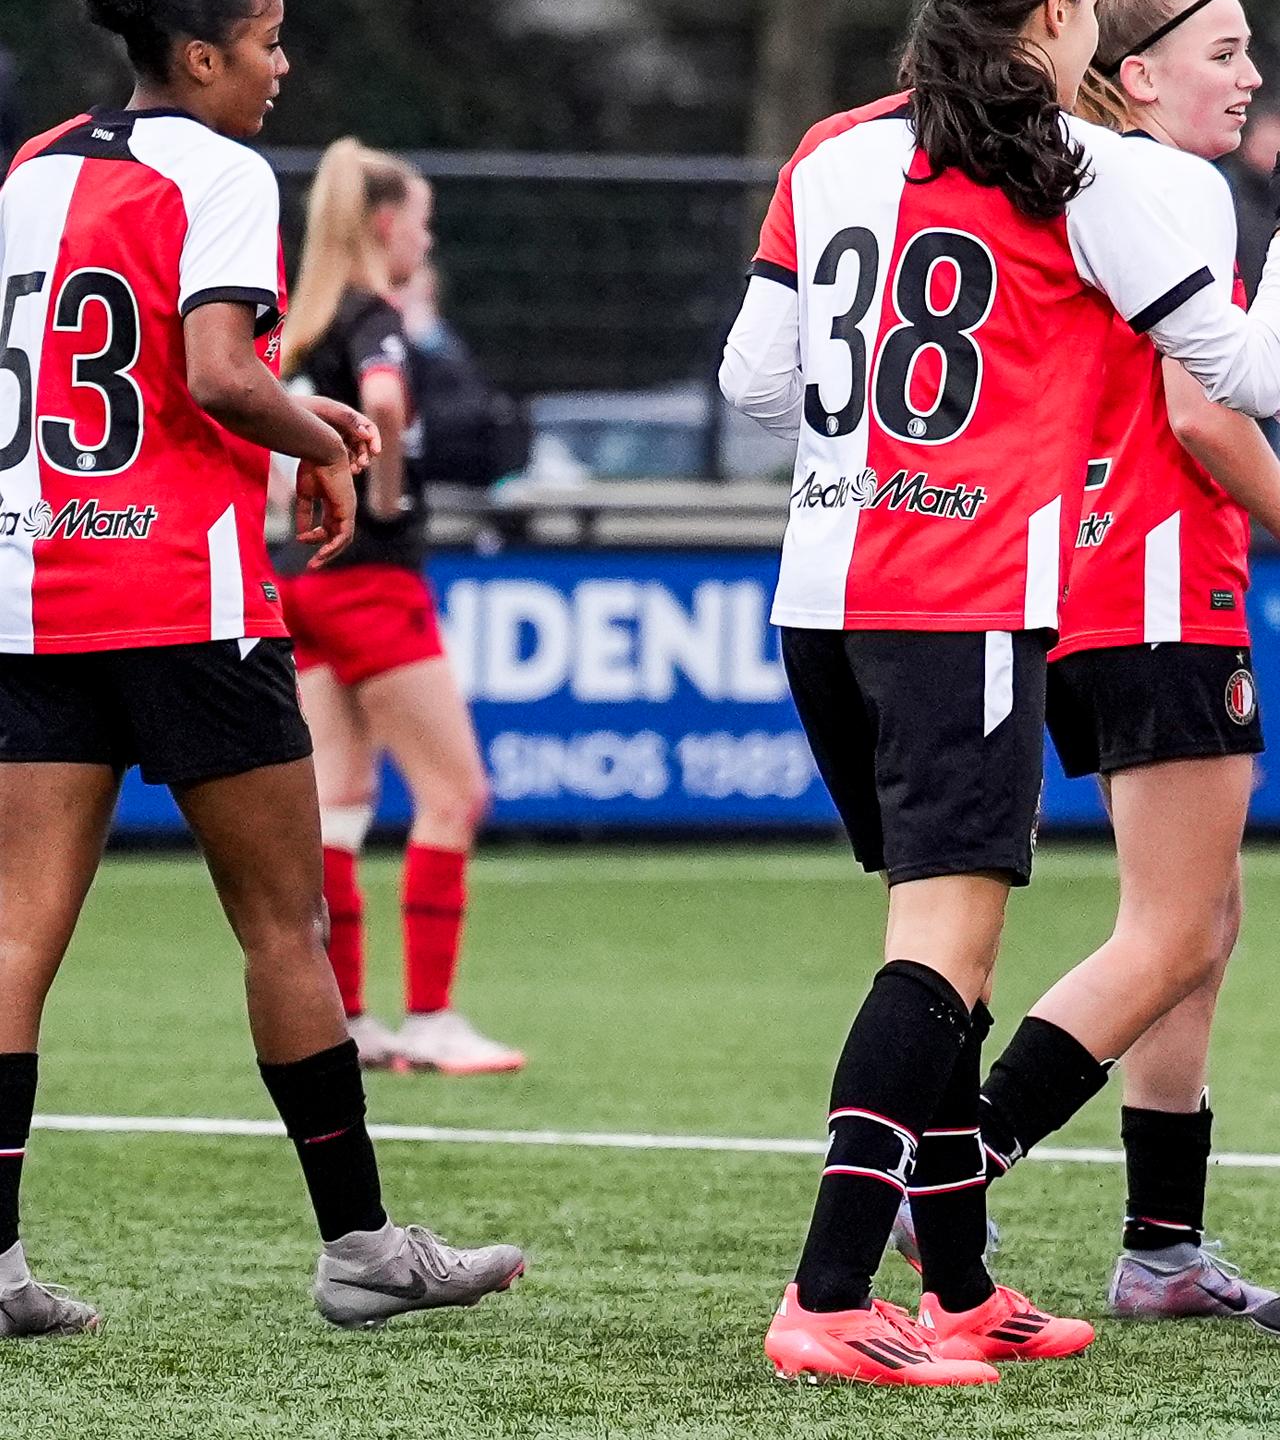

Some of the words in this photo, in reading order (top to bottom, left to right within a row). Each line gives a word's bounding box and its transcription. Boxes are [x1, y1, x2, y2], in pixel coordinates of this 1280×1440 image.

[0, 267, 145, 477] 53
[803, 226, 998, 446] 38
[47, 498, 159, 540] Markt
[871, 469, 988, 520] Markt
